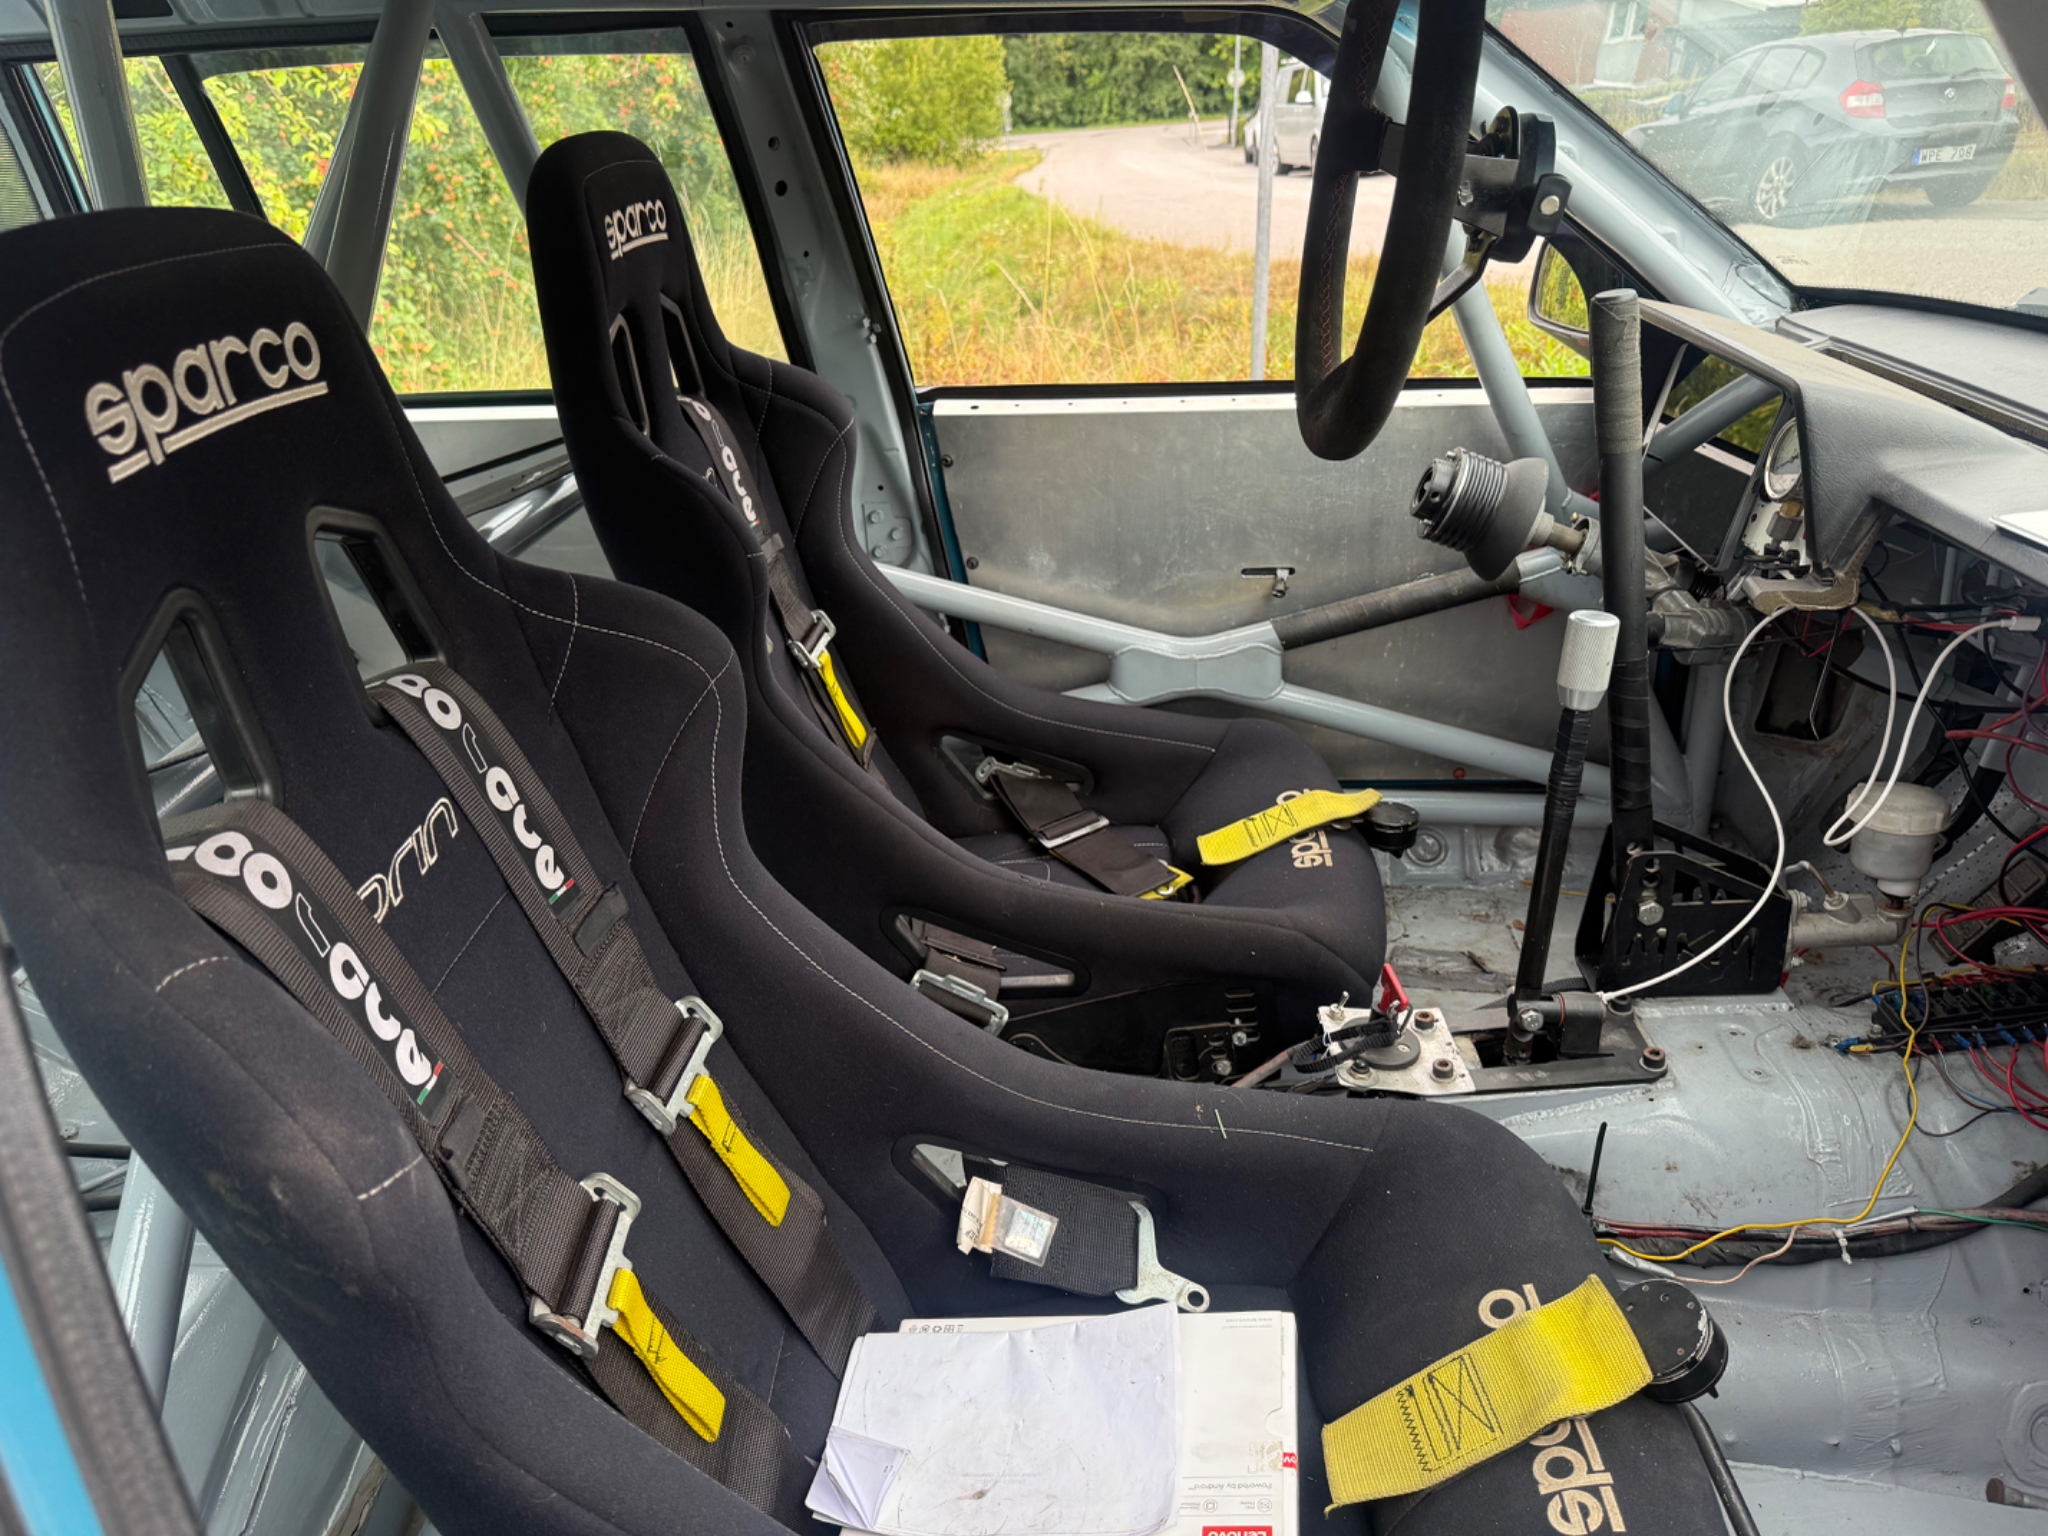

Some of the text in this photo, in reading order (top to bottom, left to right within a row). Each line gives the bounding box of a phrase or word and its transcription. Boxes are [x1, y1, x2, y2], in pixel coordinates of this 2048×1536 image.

[1921, 149, 1942, 162] WPE
[604, 199, 668, 258] sparco
[85, 322, 322, 466] sparco
[1226, 1481, 1236, 1490] by
[1238, 1482, 1272, 1490] Powered
